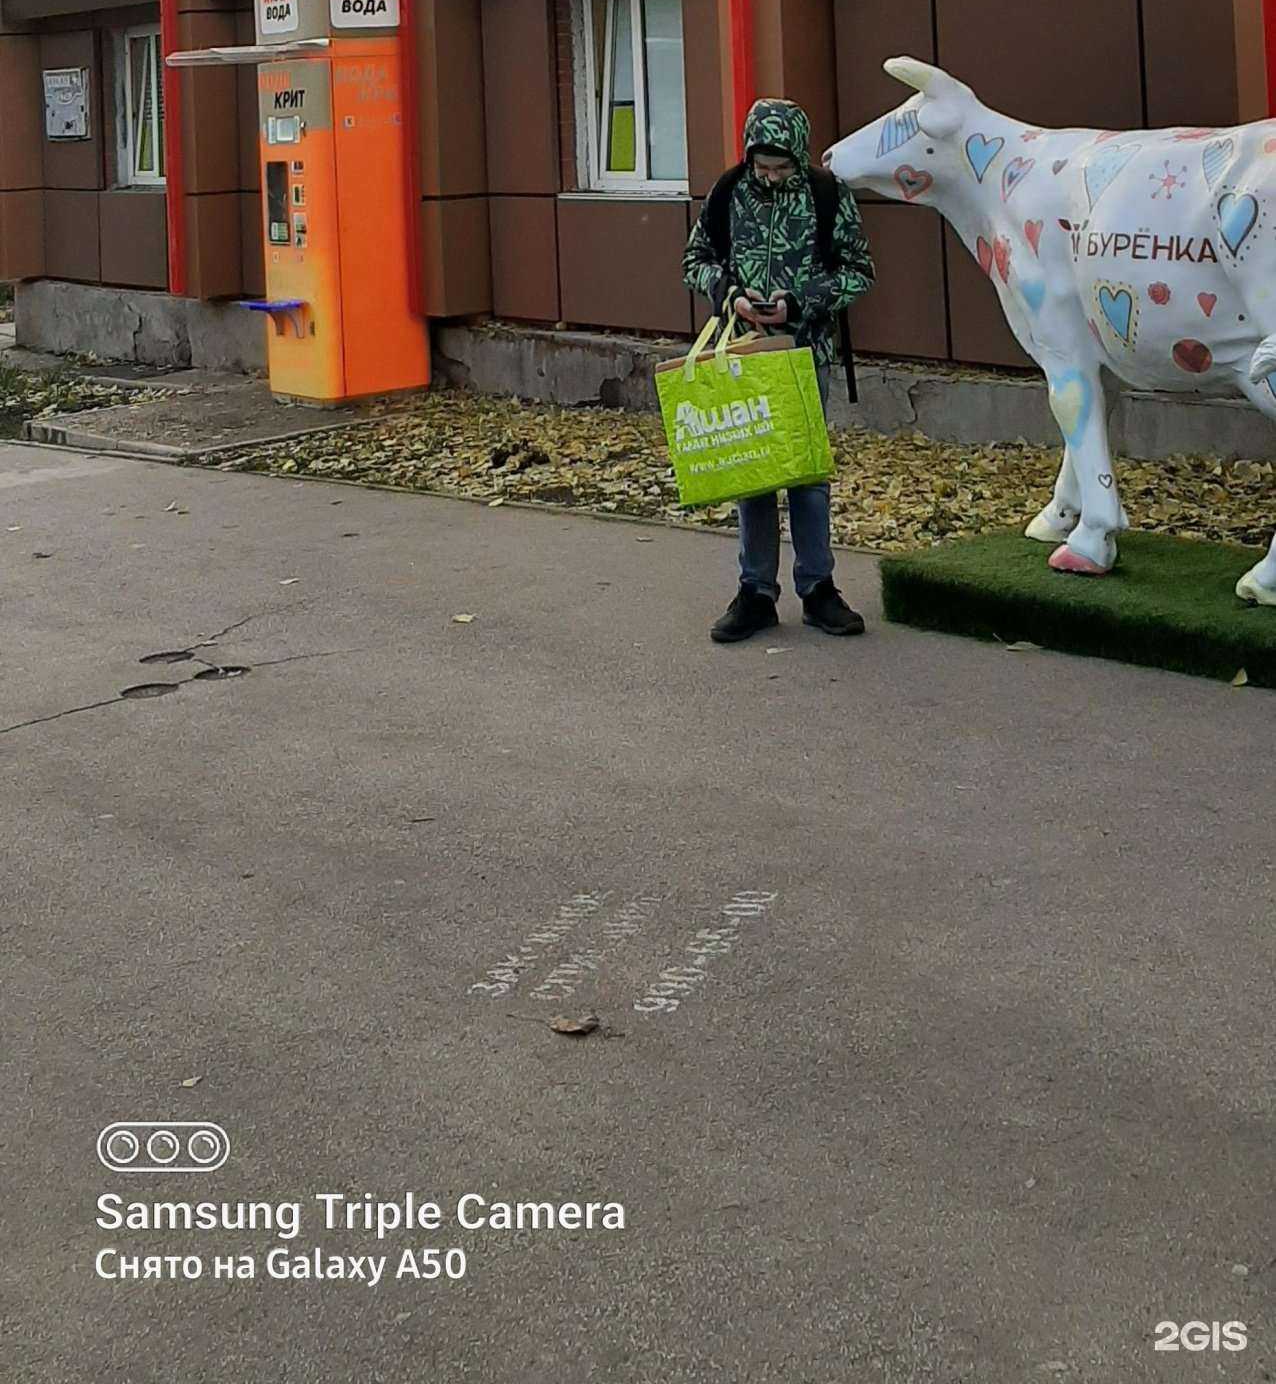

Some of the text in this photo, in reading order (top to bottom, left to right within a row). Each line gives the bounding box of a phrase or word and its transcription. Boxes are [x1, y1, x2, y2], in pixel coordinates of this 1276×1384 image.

[266, 2, 291, 22] ВОДА
[341, 0, 387, 16] ВОДА
[274, 89, 306, 110] КРИТ
[1087, 226, 1219, 264] БУРЁНКА
